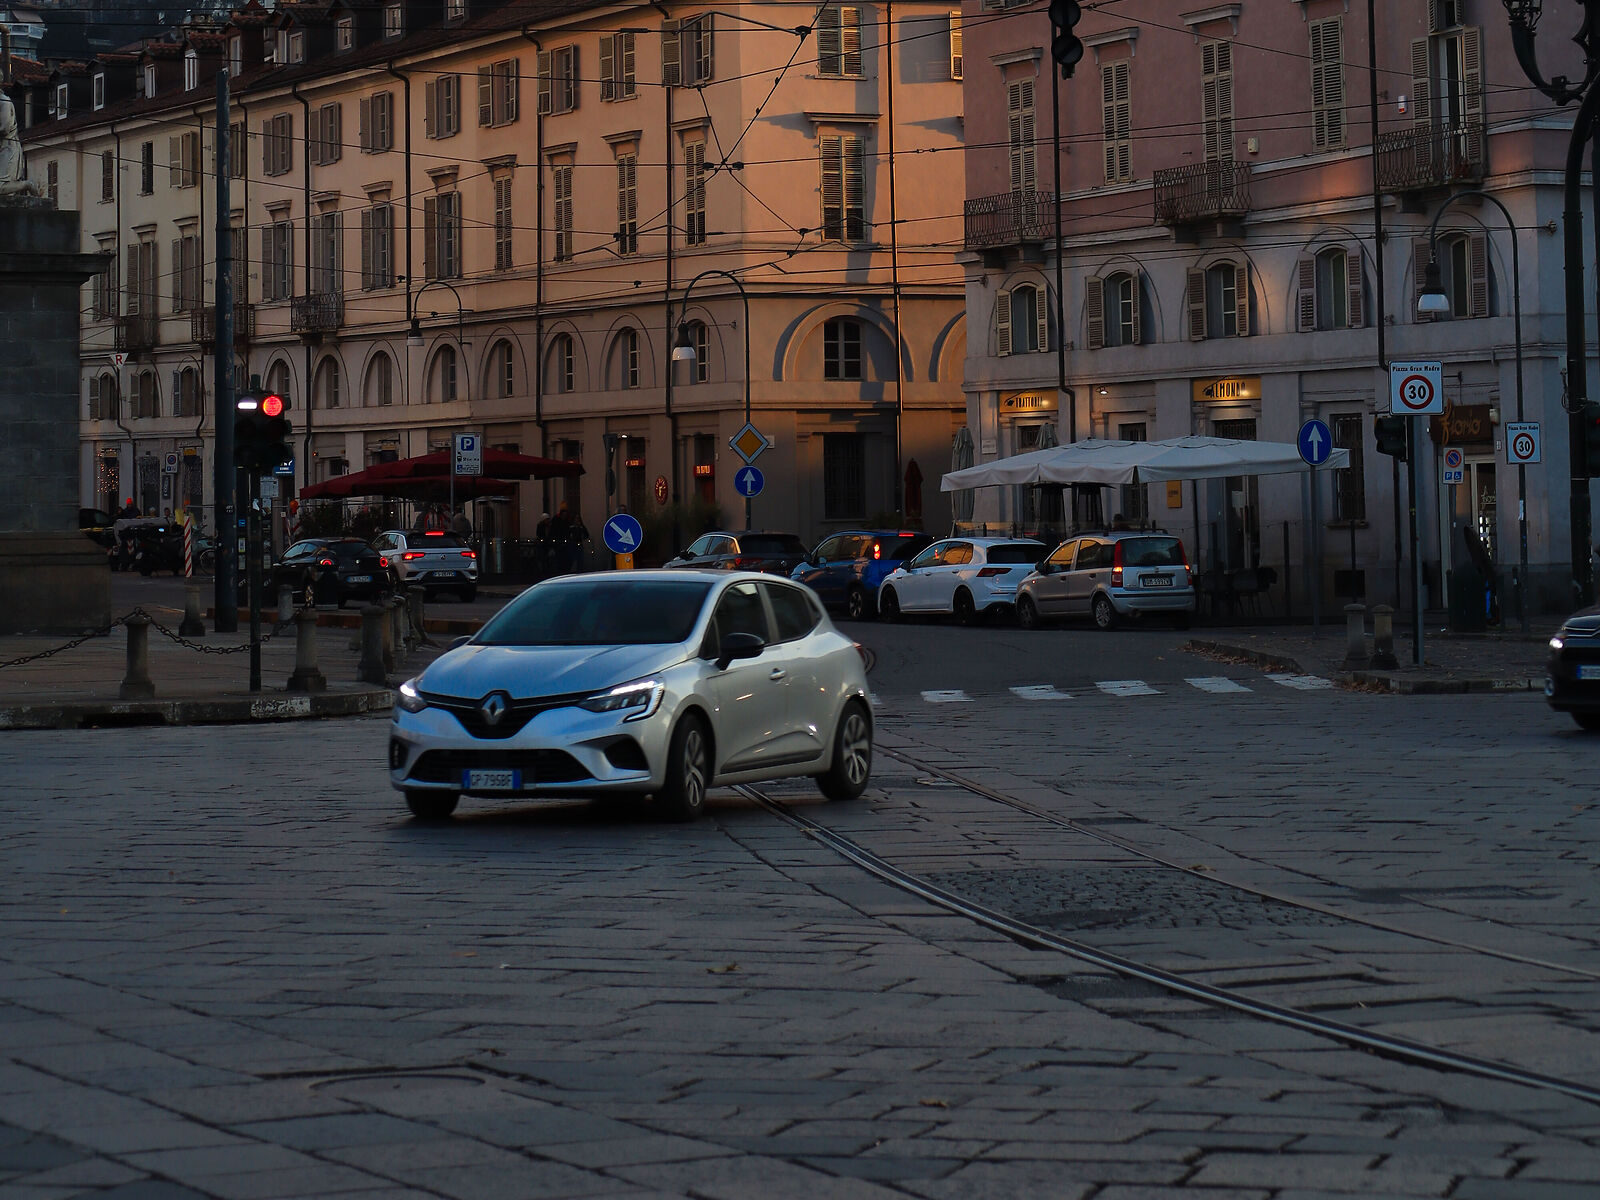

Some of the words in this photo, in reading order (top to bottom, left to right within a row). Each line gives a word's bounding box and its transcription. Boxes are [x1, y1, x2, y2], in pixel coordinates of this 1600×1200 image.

[115, 354, 123, 365] R
[1408, 385, 1427, 400] 30
[463, 438, 472, 450] P
[1518, 441, 1531, 452] 30
